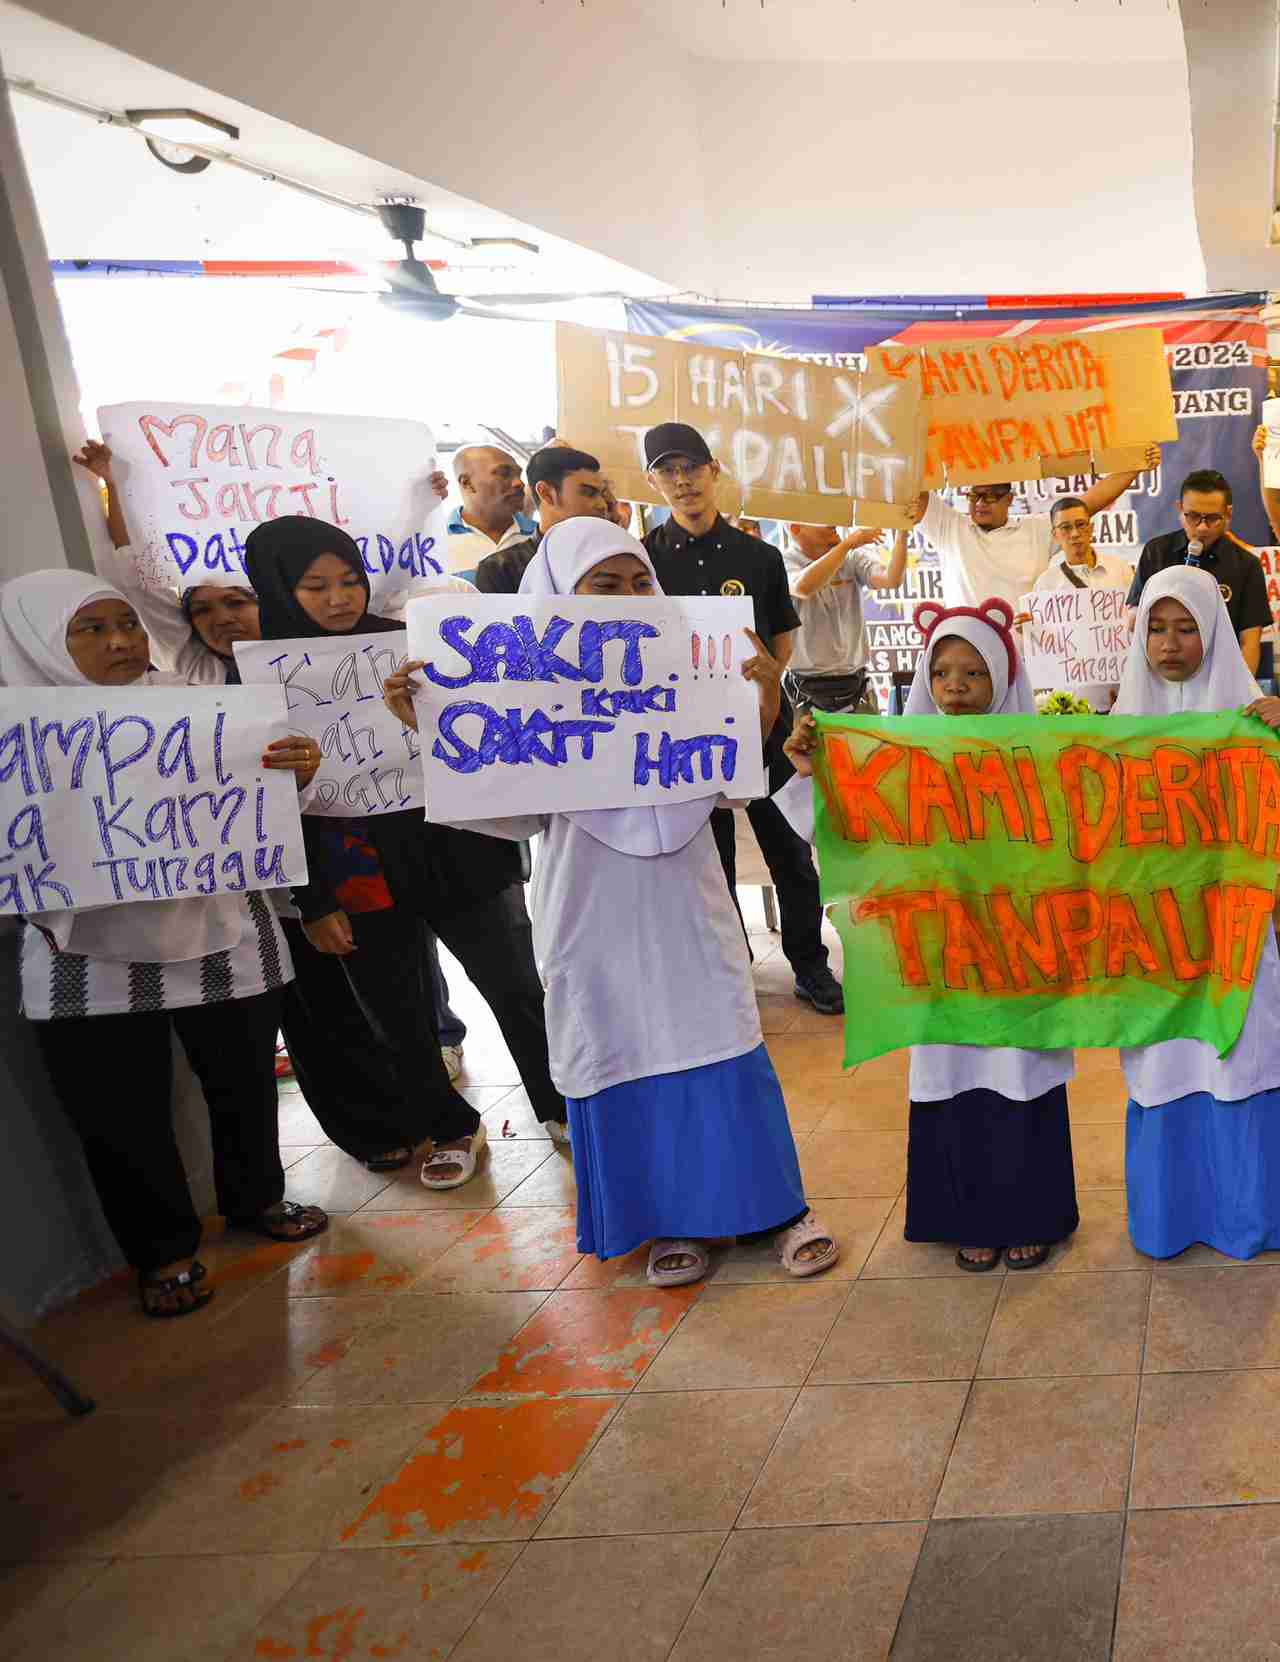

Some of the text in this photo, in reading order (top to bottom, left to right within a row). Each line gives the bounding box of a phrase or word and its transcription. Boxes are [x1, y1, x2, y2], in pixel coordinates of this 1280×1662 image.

[606, 336, 659, 409] 15
[689, 354, 809, 420] HARI
[1175, 343, 1249, 367] 2024
[822, 729, 1054, 848] KAMI
